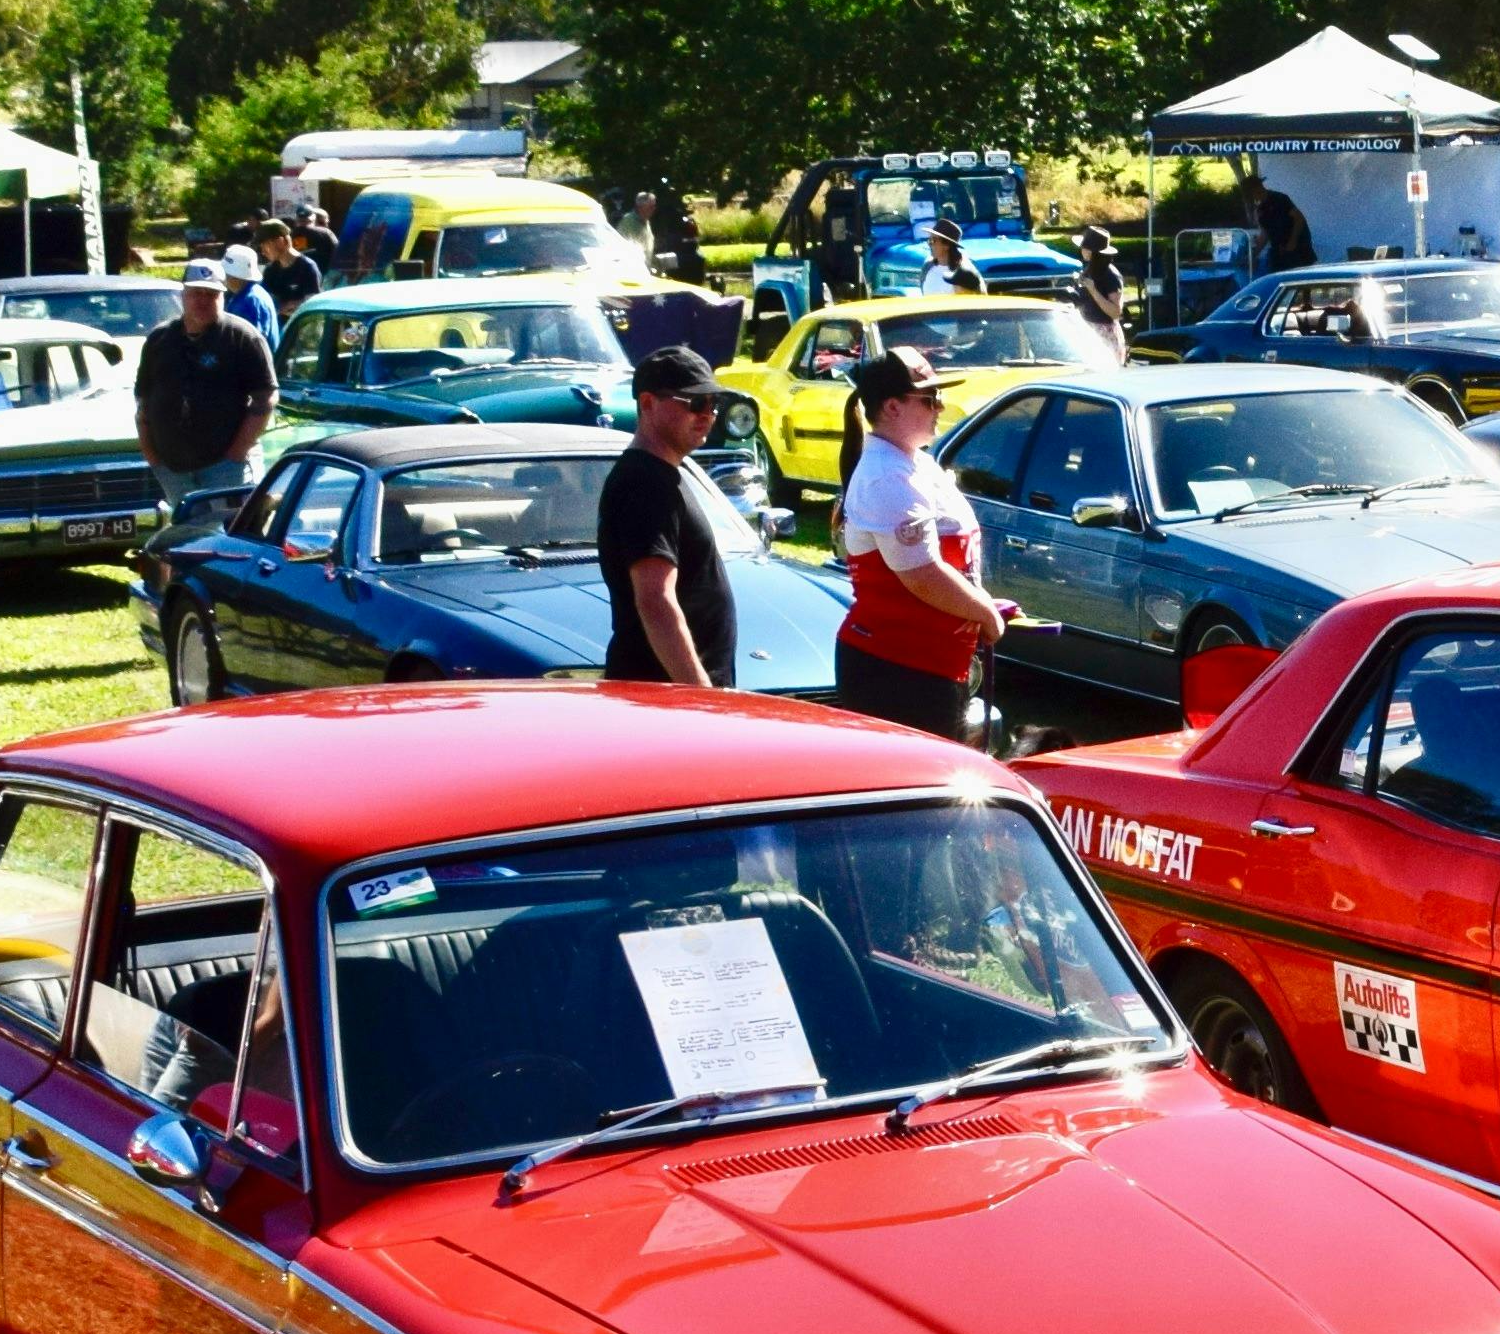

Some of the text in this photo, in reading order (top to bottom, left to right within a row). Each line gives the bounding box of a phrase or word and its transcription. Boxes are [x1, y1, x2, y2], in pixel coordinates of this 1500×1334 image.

[1209, 138, 1401, 154] HIGH COUNTRY TECHNOLOGY
[1100, 814, 1203, 881] MOFFAT
[361, 880, 391, 901] 23
[1343, 973, 1411, 1019] Autolite
